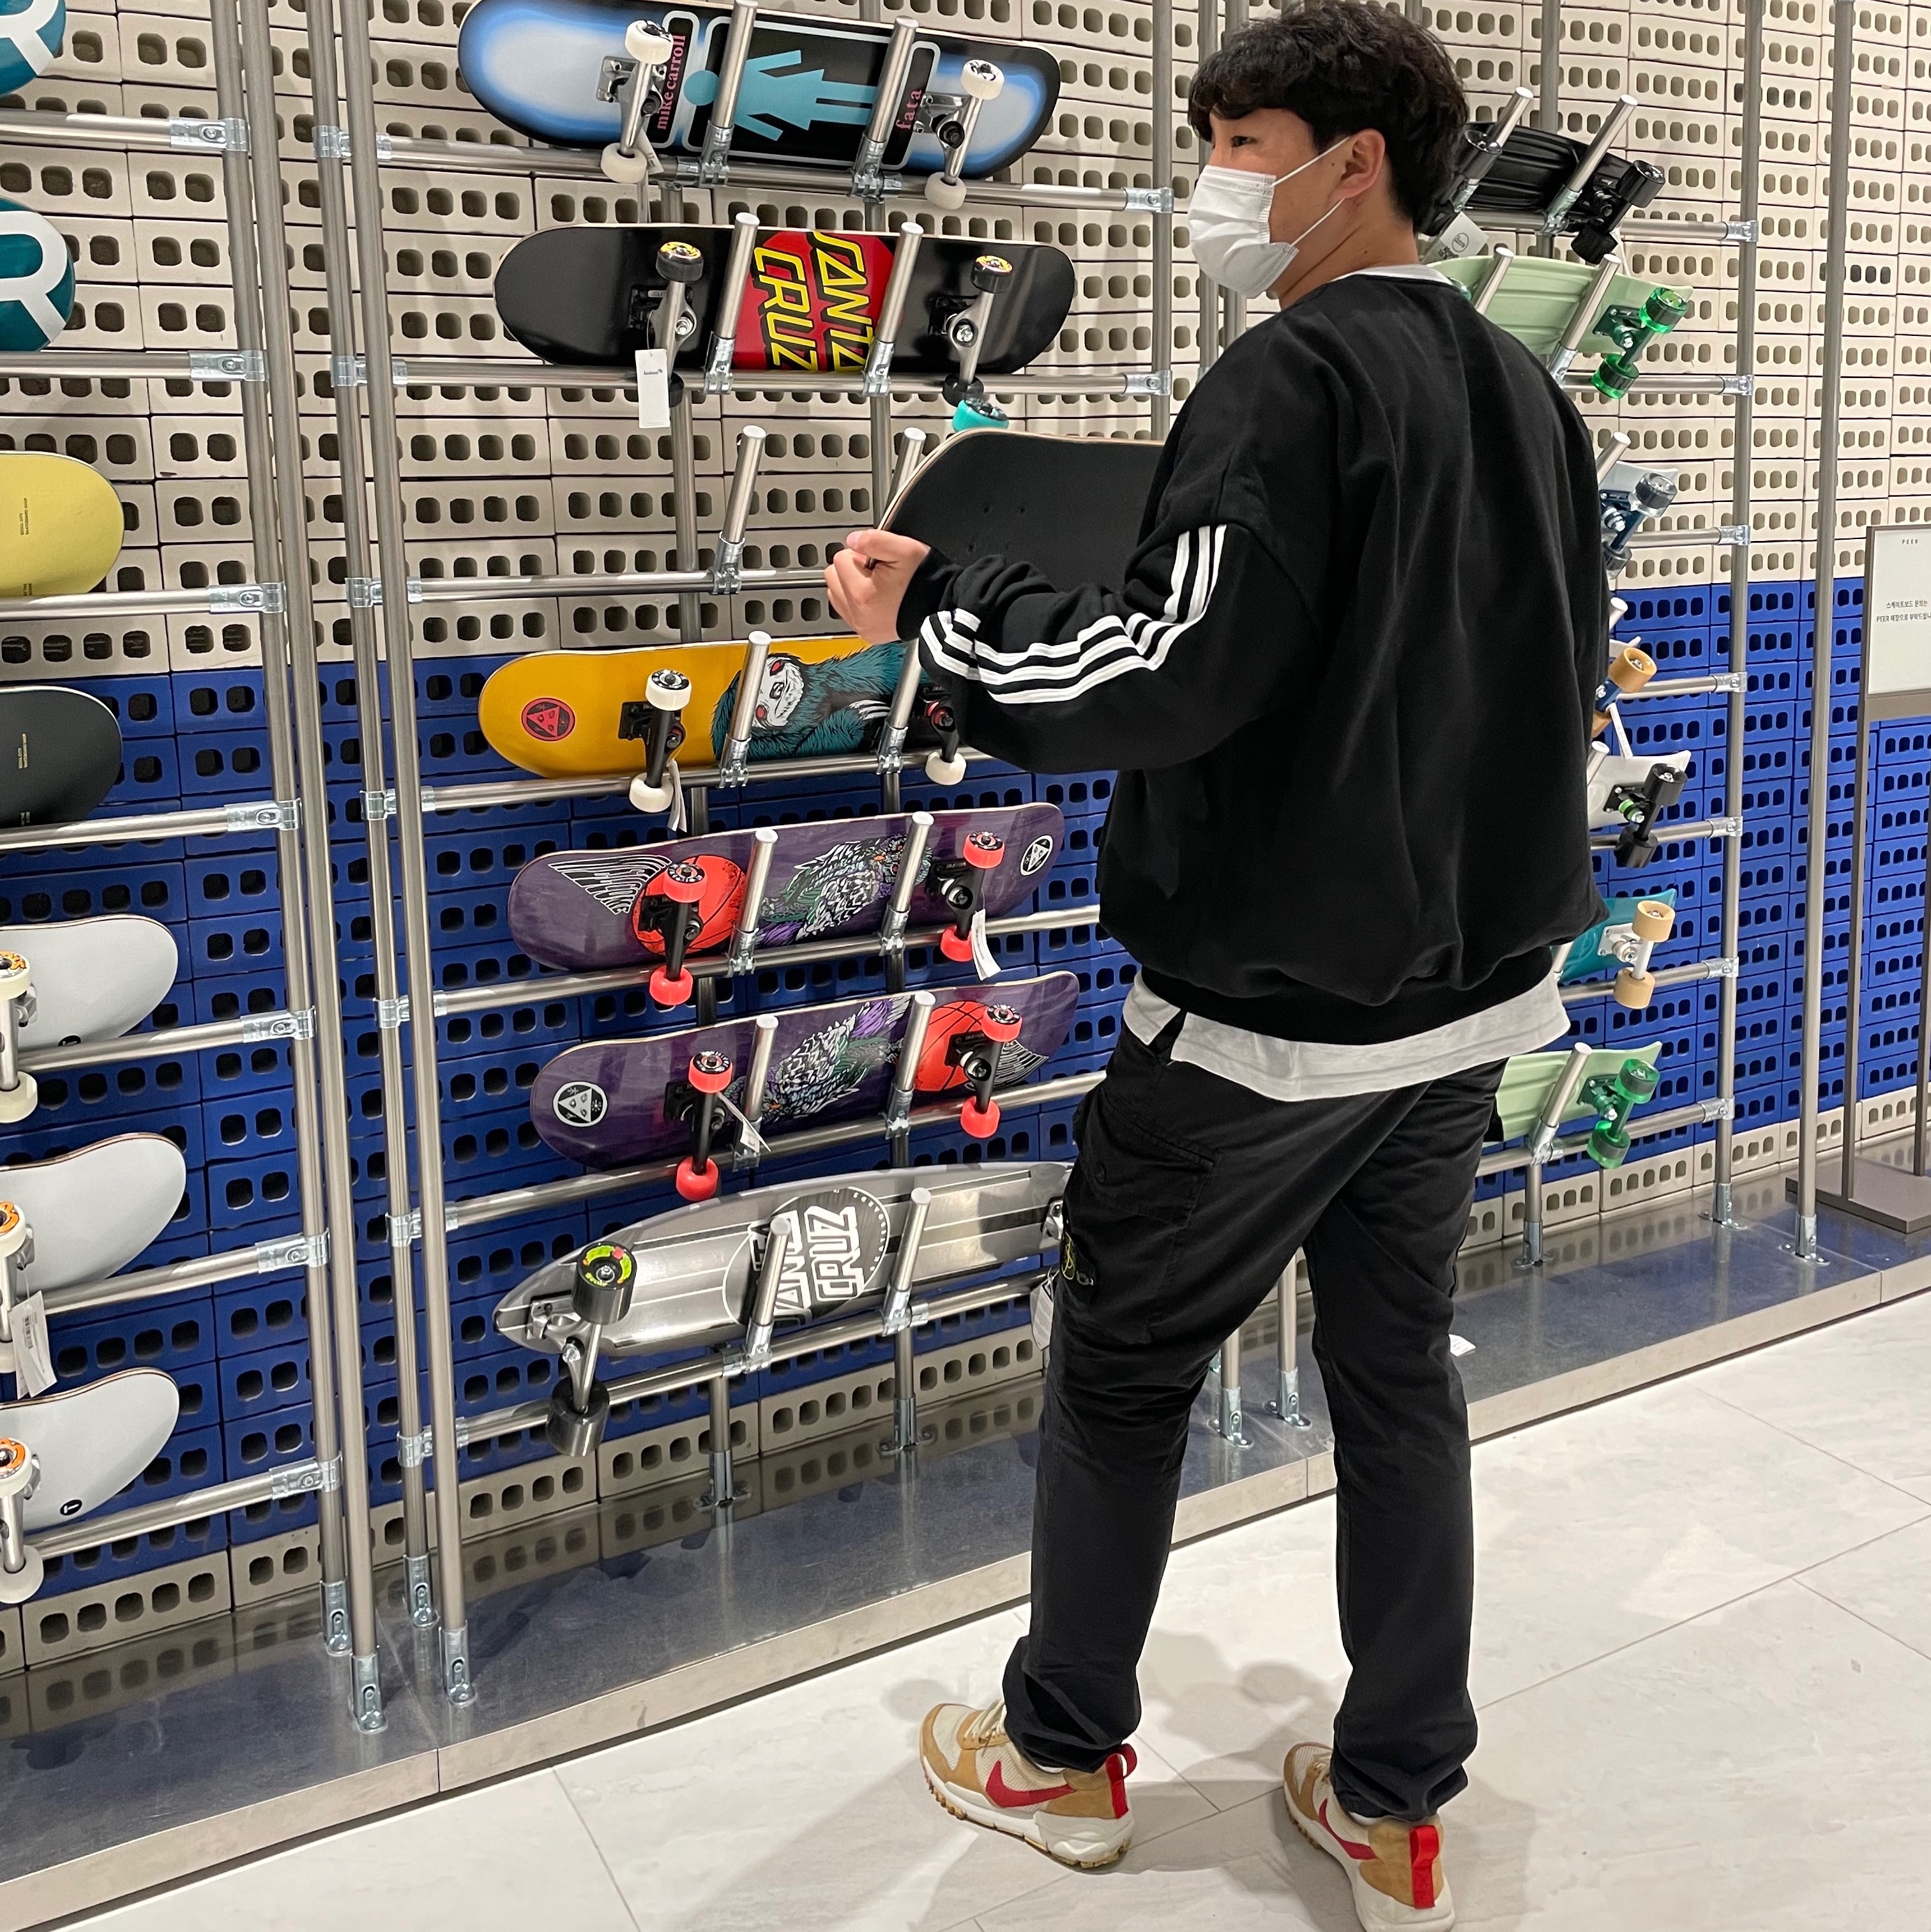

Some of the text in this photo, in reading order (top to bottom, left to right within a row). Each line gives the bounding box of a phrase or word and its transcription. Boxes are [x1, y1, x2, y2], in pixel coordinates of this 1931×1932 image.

[657, 35, 686, 130] mike carroll
[895, 89, 922, 130] fata
[753, 247, 819, 371] CRUZ
[812, 231, 874, 371] SANTA
[547, 853, 673, 915] WELCOME
[803, 1205, 865, 1302] CRUZ
